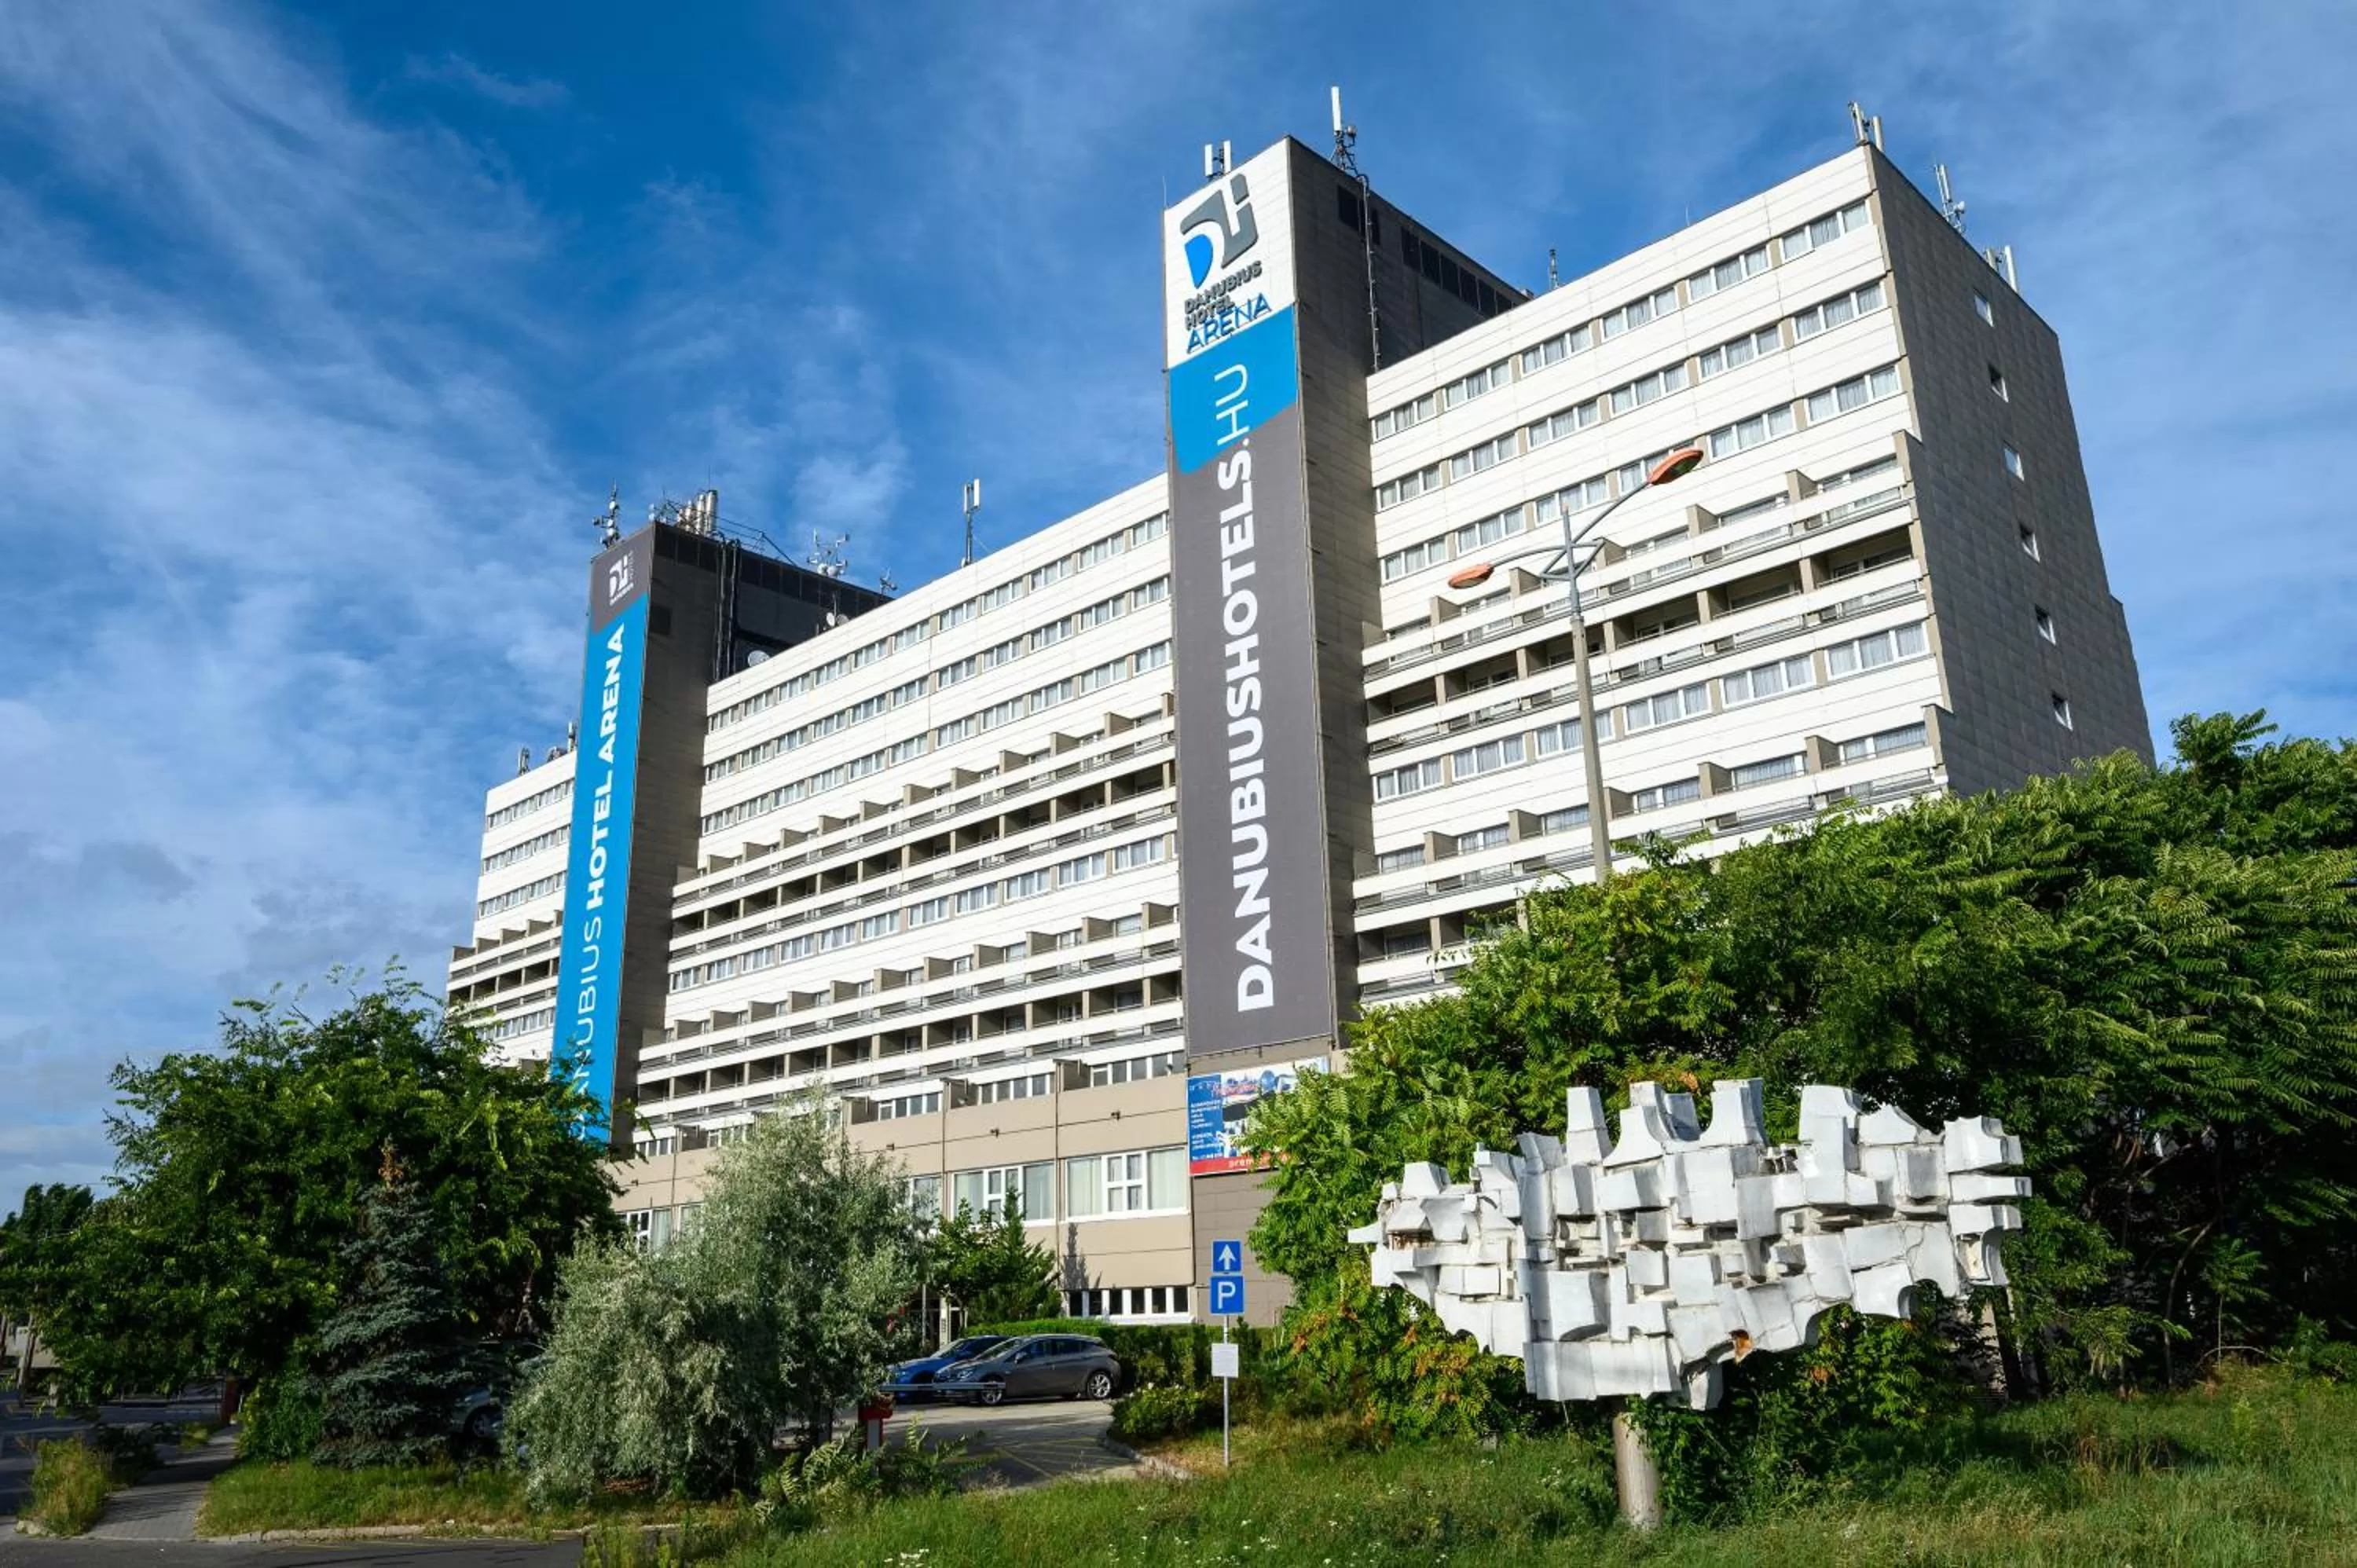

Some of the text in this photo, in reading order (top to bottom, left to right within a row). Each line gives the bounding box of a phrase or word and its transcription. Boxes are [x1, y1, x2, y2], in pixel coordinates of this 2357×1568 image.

[1185, 260, 1263, 314] DANUBIUS
[1185, 295, 1235, 331] HOTEL
[1186, 292, 1272, 354] ARENA
[598, 622, 625, 764] ARENA
[1214, 363, 1274, 1012] DANUBIUSHOTELS.HU
[586, 770, 613, 911] HOTEL
[1219, 1281, 1237, 1310] P
